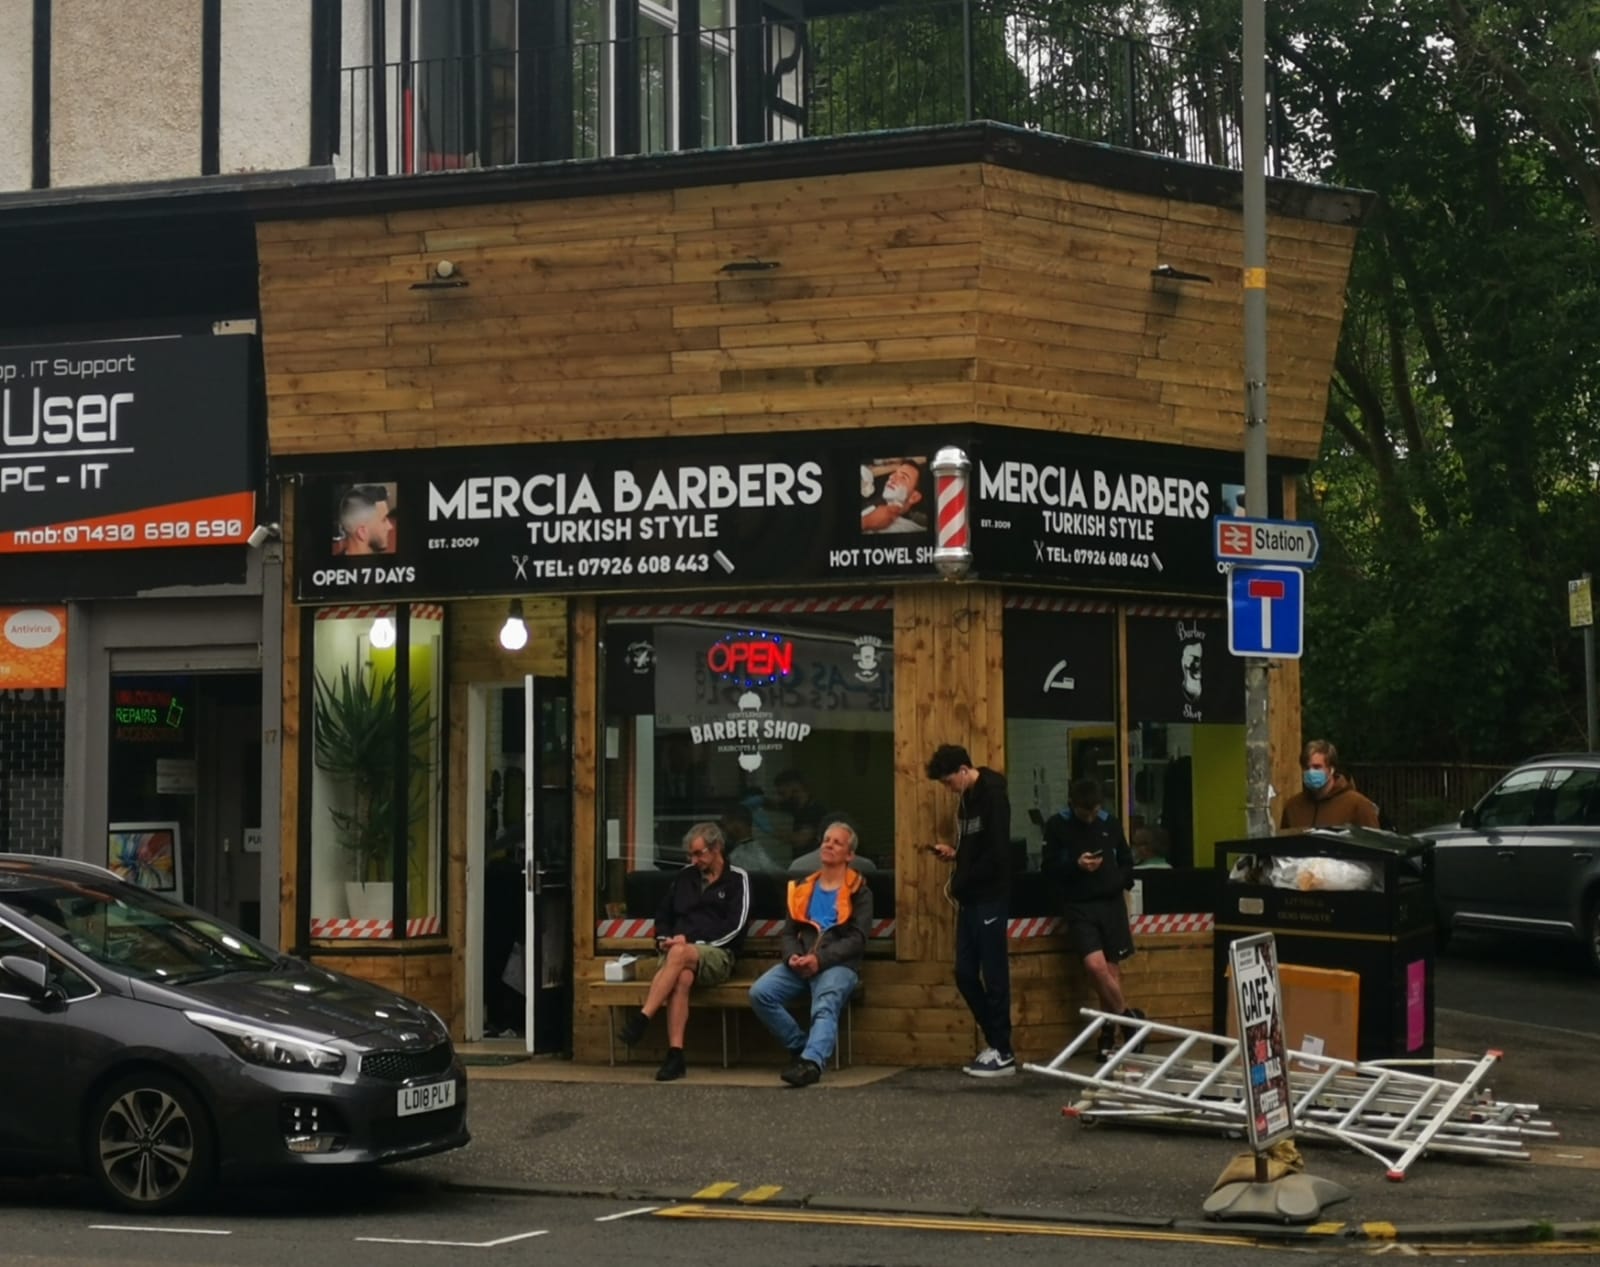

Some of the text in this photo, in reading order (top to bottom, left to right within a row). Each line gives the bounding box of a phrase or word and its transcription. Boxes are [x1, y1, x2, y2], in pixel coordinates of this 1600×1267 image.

[30, 359, 48, 377] IT
[53, 354, 136, 379] Support
[3, 387, 134, 445] User
[0, 465, 46, 493] PC
[80, 463, 109, 489] IT
[979, 459, 1210, 519] MERCIA BARBERS
[428, 461, 823, 521] MERCIA BARBERS
[144, 522, 190, 540] 690
[195, 520, 242, 538] 690
[526, 514, 719, 545] TURKISH STYLE
[1042, 511, 1154, 541] TURKISH STYLE
[428, 537, 480, 549] EST. 2009
[1255, 528, 1305, 552] Station
[533, 554, 709, 578] TEL: 07926 608 443
[830, 546, 934, 567] HOT TOWEL SH
[1046, 547, 1149, 569] TEL: 07926 608 443
[312, 566, 415, 586] OPEN 7 DAYS
[10, 625, 52, 634] Antivirus
[707, 640, 793, 676] OPEN
[116, 707, 157, 723] REPAIRS
[690, 719, 811, 745] BARBER SHOP
[404, 1088, 429, 1110] LD18
